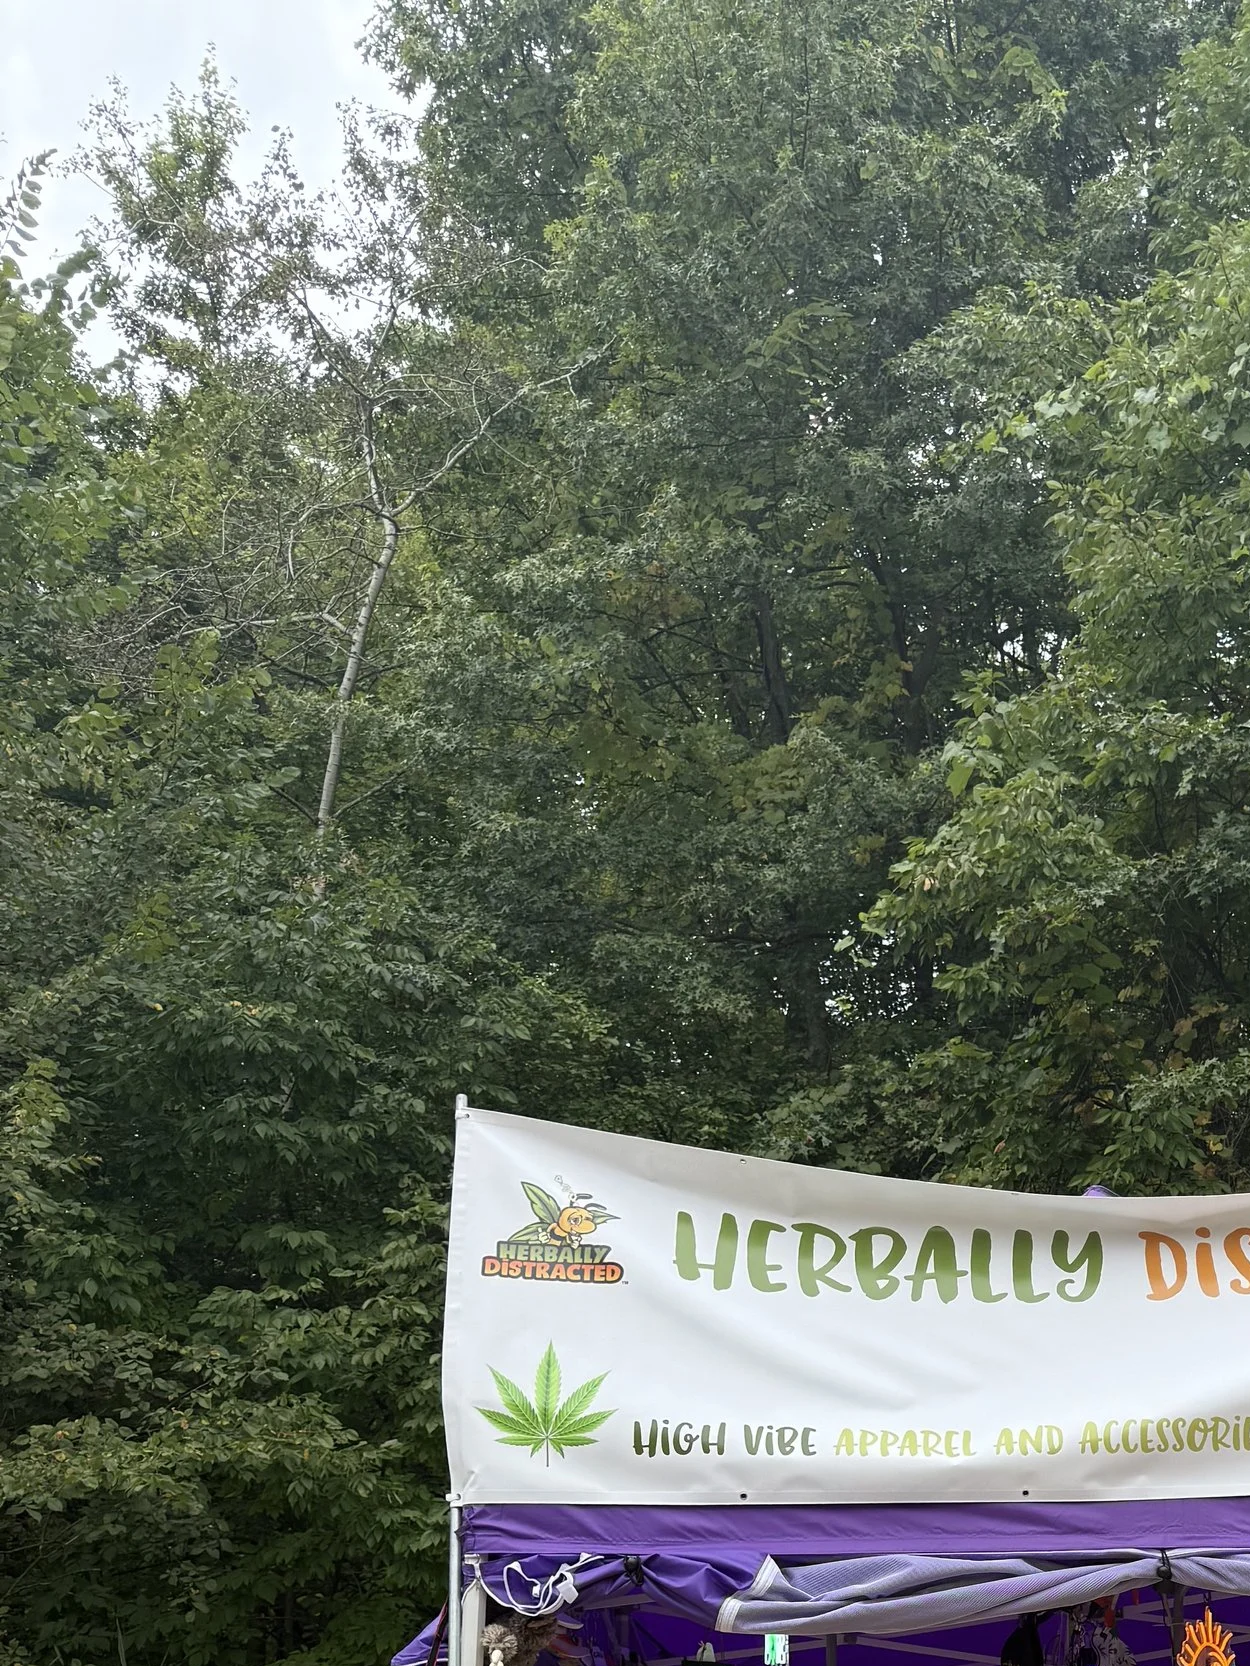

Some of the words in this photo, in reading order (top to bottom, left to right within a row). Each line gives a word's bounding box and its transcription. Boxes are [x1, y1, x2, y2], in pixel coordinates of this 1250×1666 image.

[500, 1242, 611, 1264] HERBALLY
[673, 1211, 1103, 1304] HERBALLY
[833, 1428, 976, 1459] APPAREL
[993, 1424, 1064, 1458] AND
